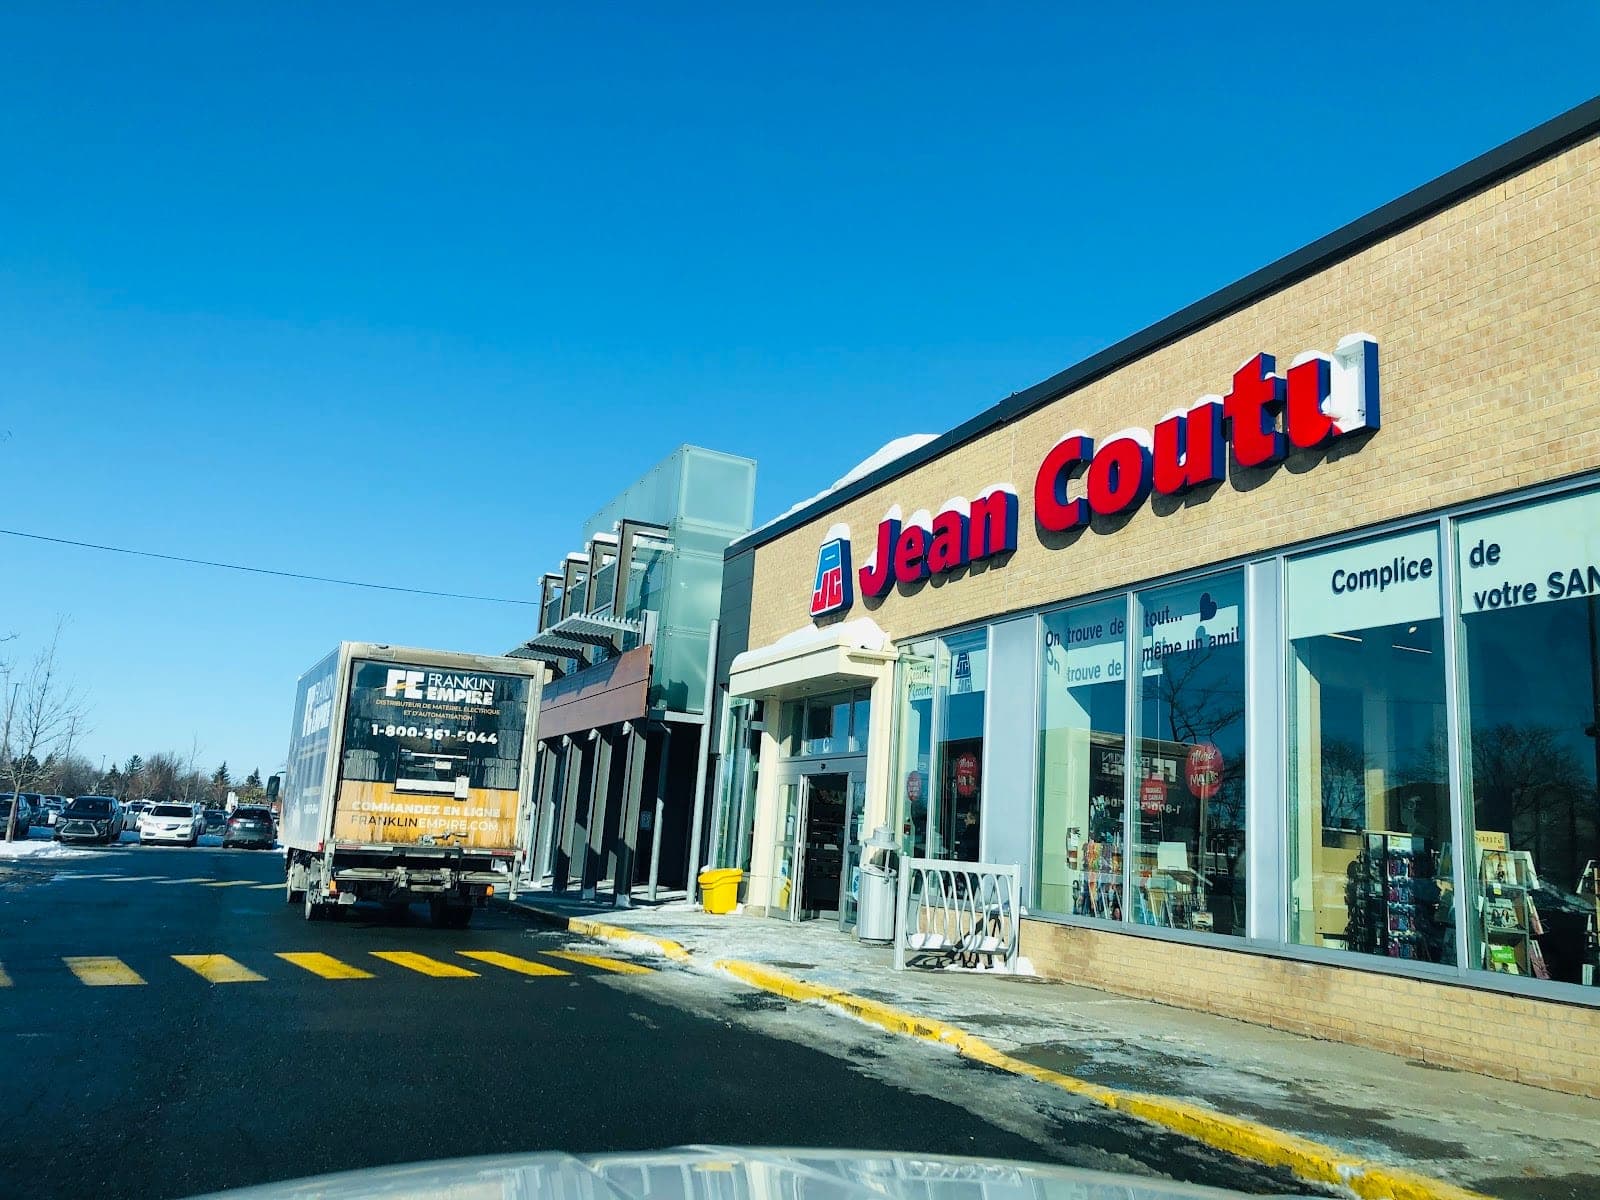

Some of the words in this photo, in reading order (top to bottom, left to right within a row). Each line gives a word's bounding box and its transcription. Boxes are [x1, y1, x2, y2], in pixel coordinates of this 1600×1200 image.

[858, 484, 1017, 598] Jean
[1331, 556, 1433, 595] Complice
[1469, 539, 1501, 569] de
[1473, 580, 1537, 611] votre
[1045, 630, 1060, 648] On
[1067, 624, 1103, 644] trouve
[1110, 617, 1124, 634] de
[1143, 642, 1182, 664] même
[1187, 638, 1203, 653] un
[1208, 627, 1240, 650] ami!
[428, 673, 495, 691] FRANKLIN
[375, 699, 421, 709] DISTRIBUTEUR
[427, 687, 493, 705] EMPIRE
[351, 801, 441, 815] COMMANDEZ
[443, 805, 461, 816] EN
[464, 807, 501, 817] LIGNE
[351, 815, 499, 831] FRANKLINEMPIRE.COM
